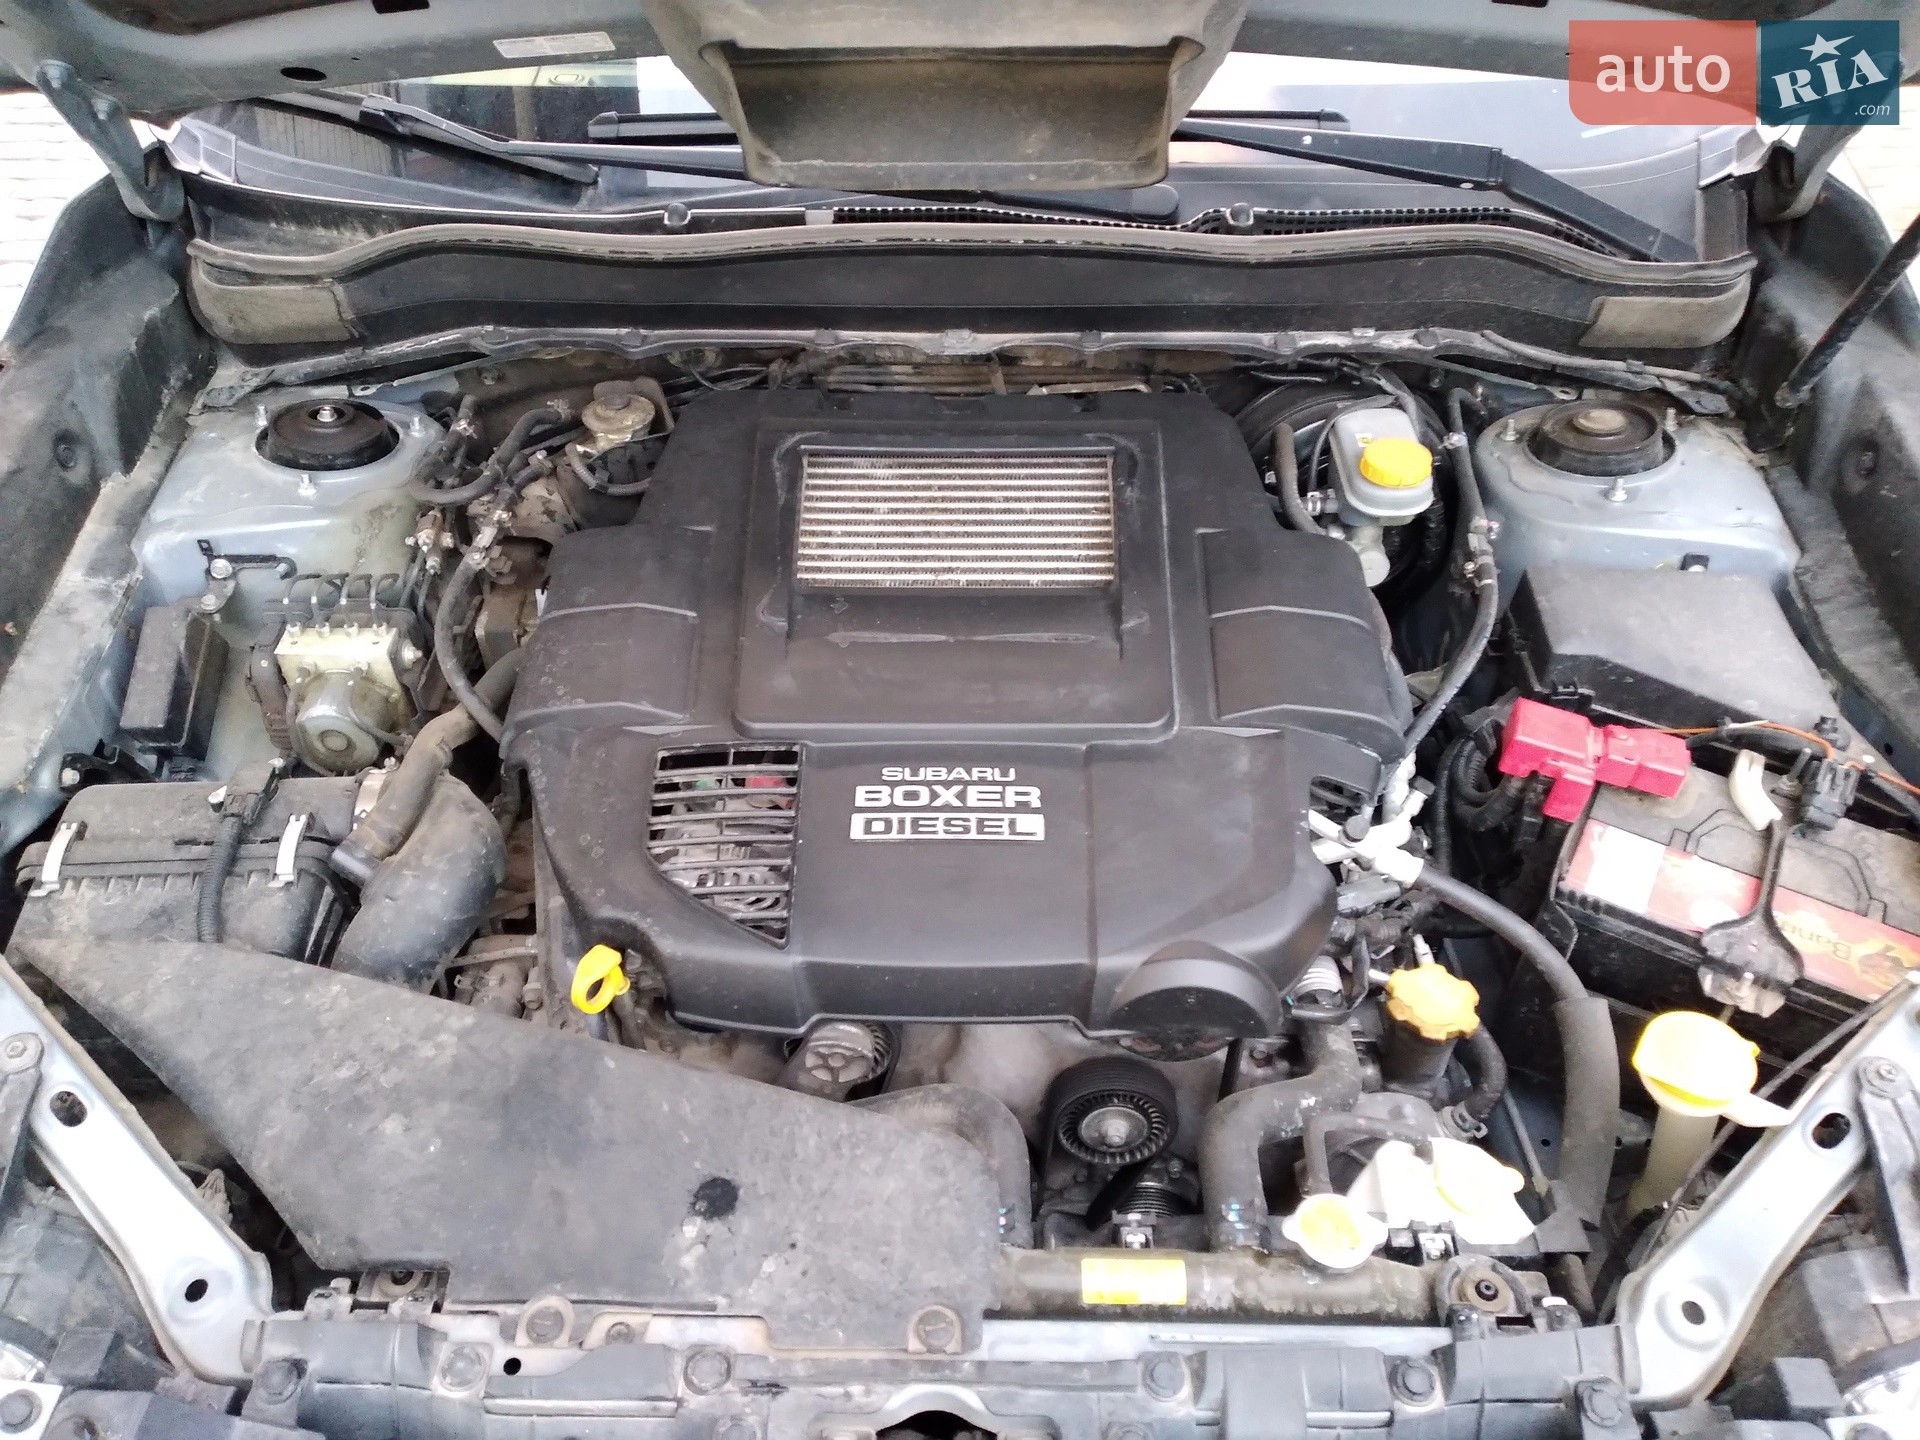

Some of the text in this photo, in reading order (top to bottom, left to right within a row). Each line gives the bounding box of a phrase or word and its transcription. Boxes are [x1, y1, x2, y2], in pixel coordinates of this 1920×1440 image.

[881, 767, 1016, 781] SUBARU
[854, 785, 1042, 808] BOXER
[862, 816, 1038, 837] DIESEL
[1779, 920, 1852, 961] Bann
